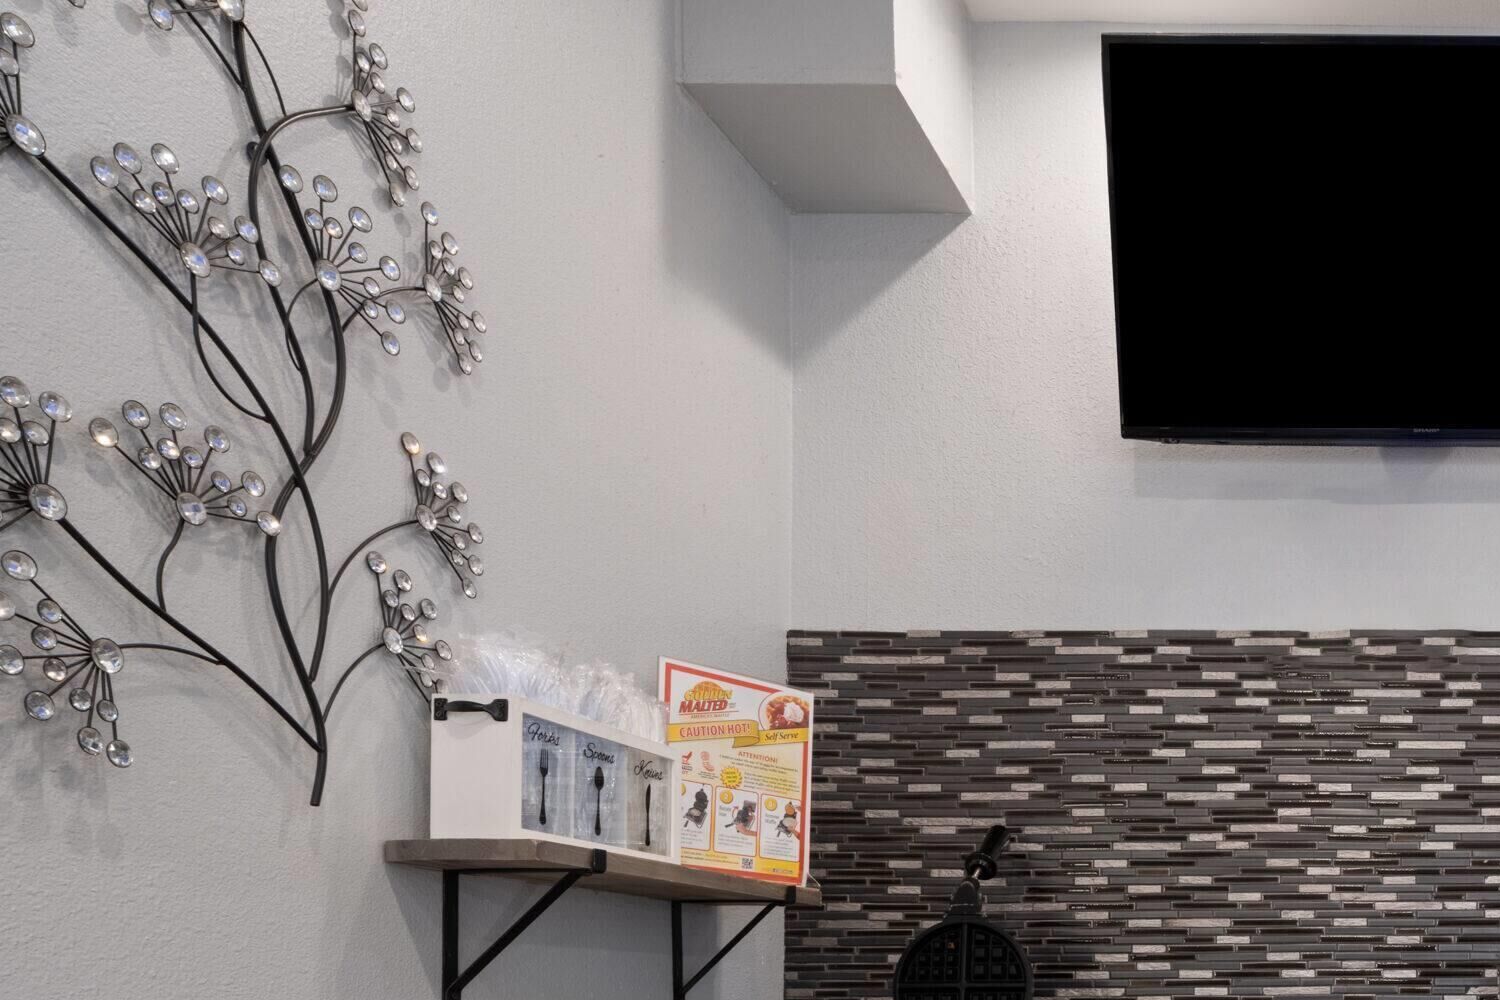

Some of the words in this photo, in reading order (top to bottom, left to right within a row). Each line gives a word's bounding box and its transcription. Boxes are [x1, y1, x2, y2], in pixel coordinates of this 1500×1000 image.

[679, 699, 728, 713] MALTED
[527, 722, 560, 746] Forks
[680, 725, 725, 738] CAUTION
[727, 723, 751, 737] HOT!
[764, 732, 779, 742] Self
[780, 732, 799, 740] Serve
[583, 742, 615, 765] Spoons
[738, 751, 778, 764] ATTENTION!
[634, 759, 664, 781] Knives
